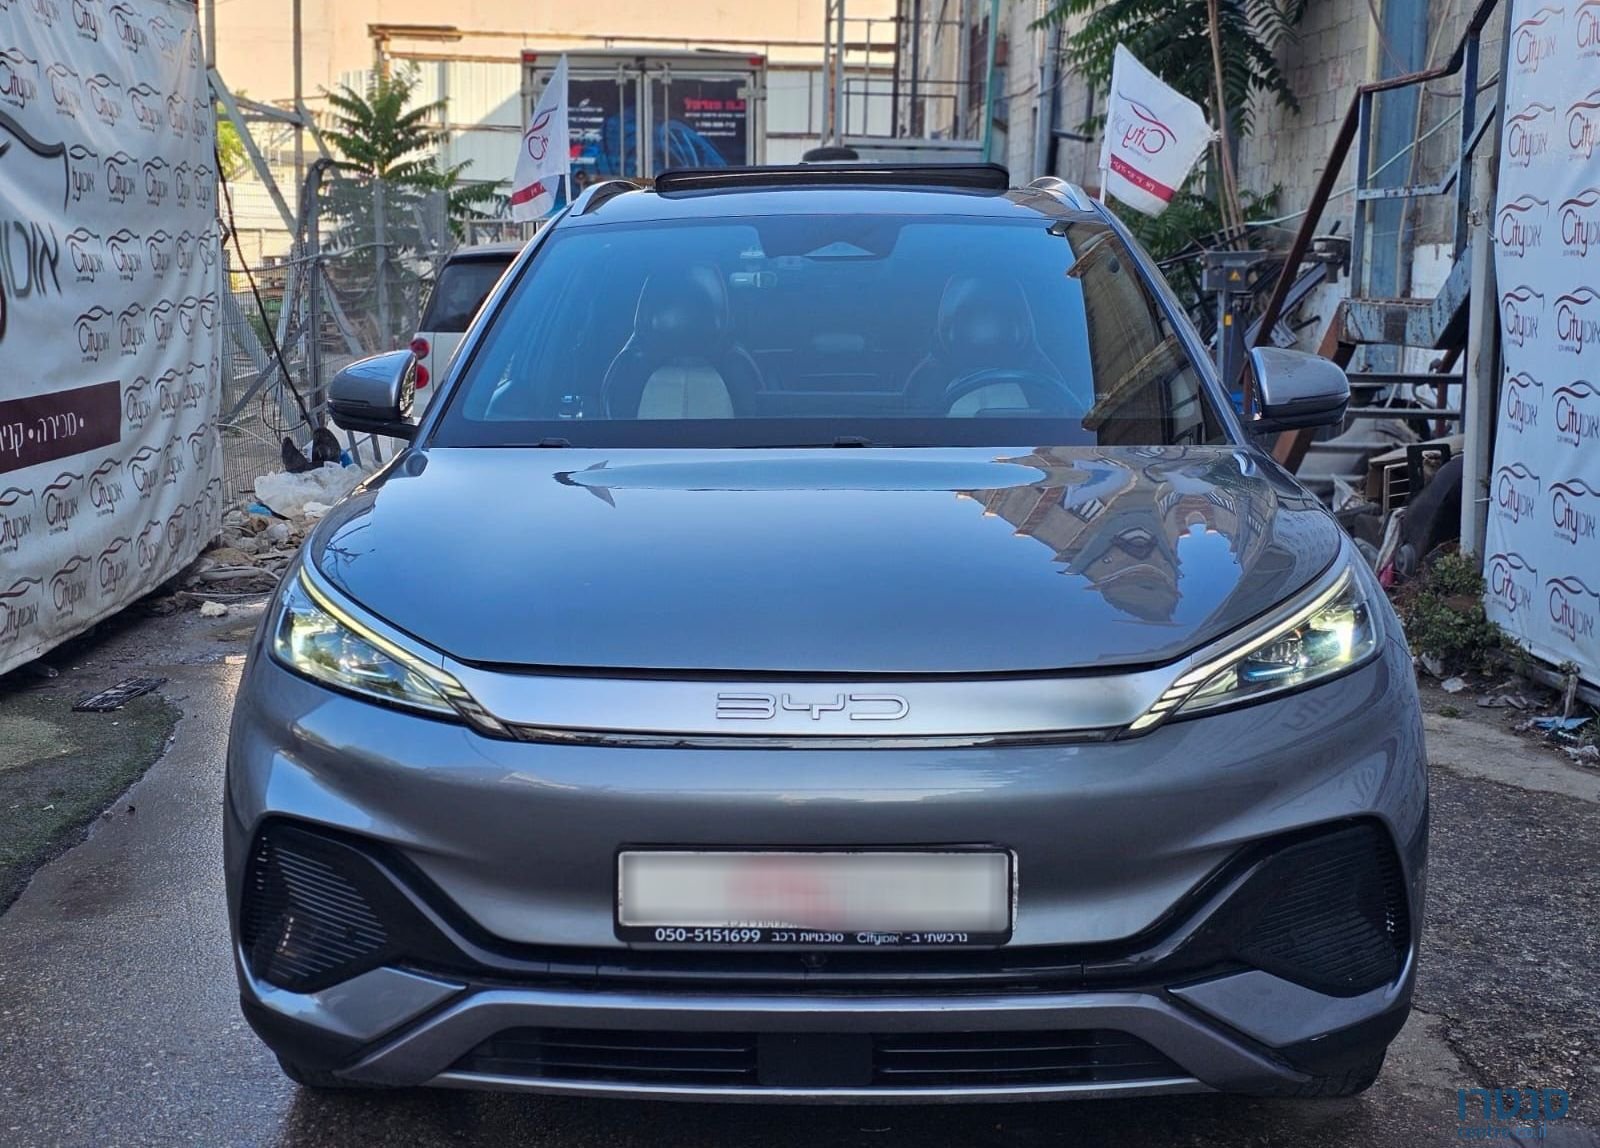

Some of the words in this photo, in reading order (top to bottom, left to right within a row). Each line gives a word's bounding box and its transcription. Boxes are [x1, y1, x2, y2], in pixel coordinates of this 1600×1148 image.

[37, 412, 77, 443] מכירה
[715, 692, 910, 721] BYD
[654, 927, 762, 943] 050-5151699
[771, 931, 796, 943] רכב
[923, 932, 968, 944] נרכשתי
